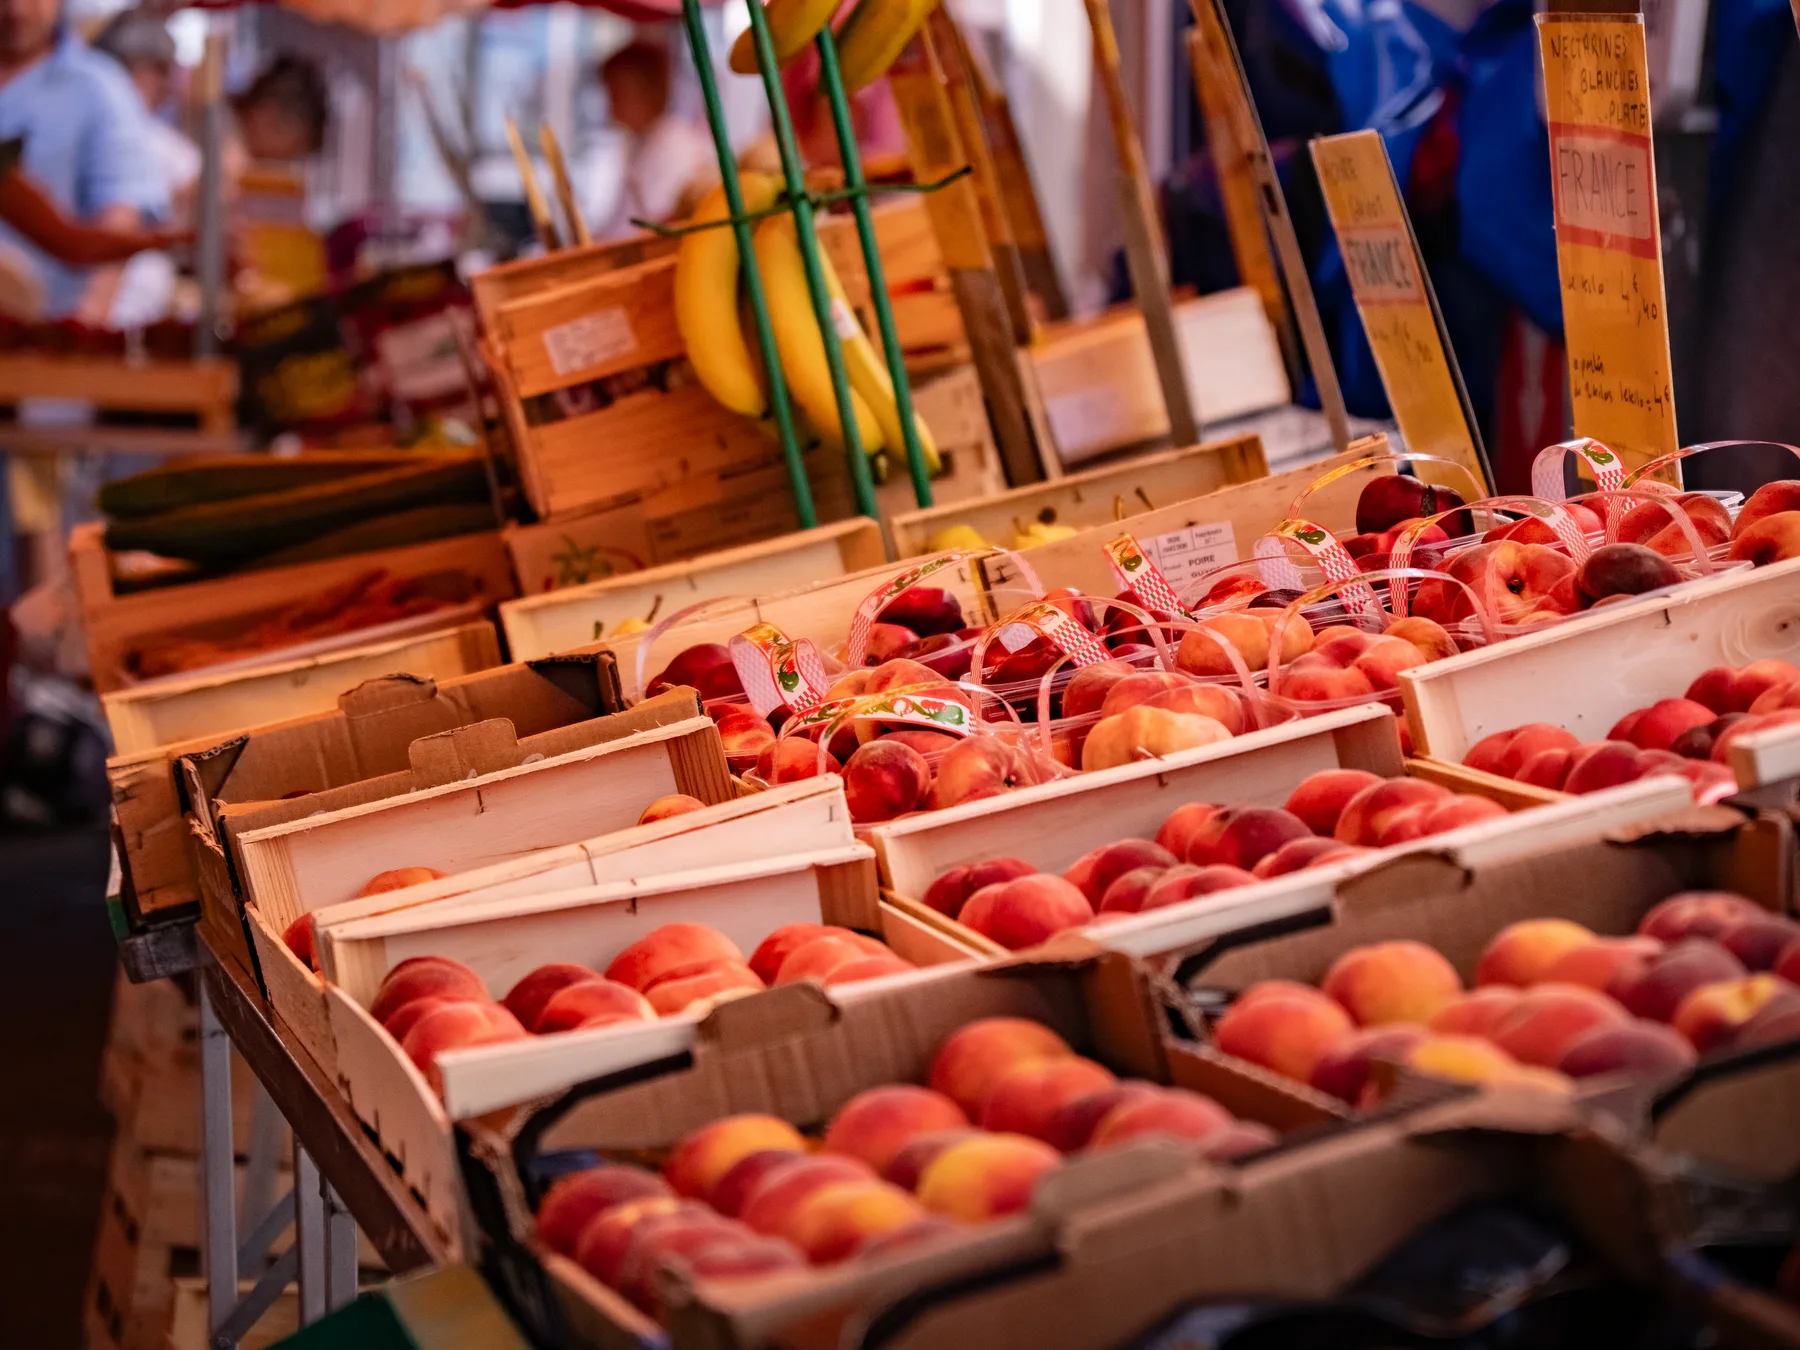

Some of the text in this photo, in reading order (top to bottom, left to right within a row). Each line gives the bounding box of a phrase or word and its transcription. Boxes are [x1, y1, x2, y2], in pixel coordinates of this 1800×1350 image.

[1551, 33, 1627, 59] NECTARINES
[1580, 68, 1639, 94] BLANCHES
[1559, 145, 1638, 218] FRANCE
[1188, 554, 1216, 567] POIRE
